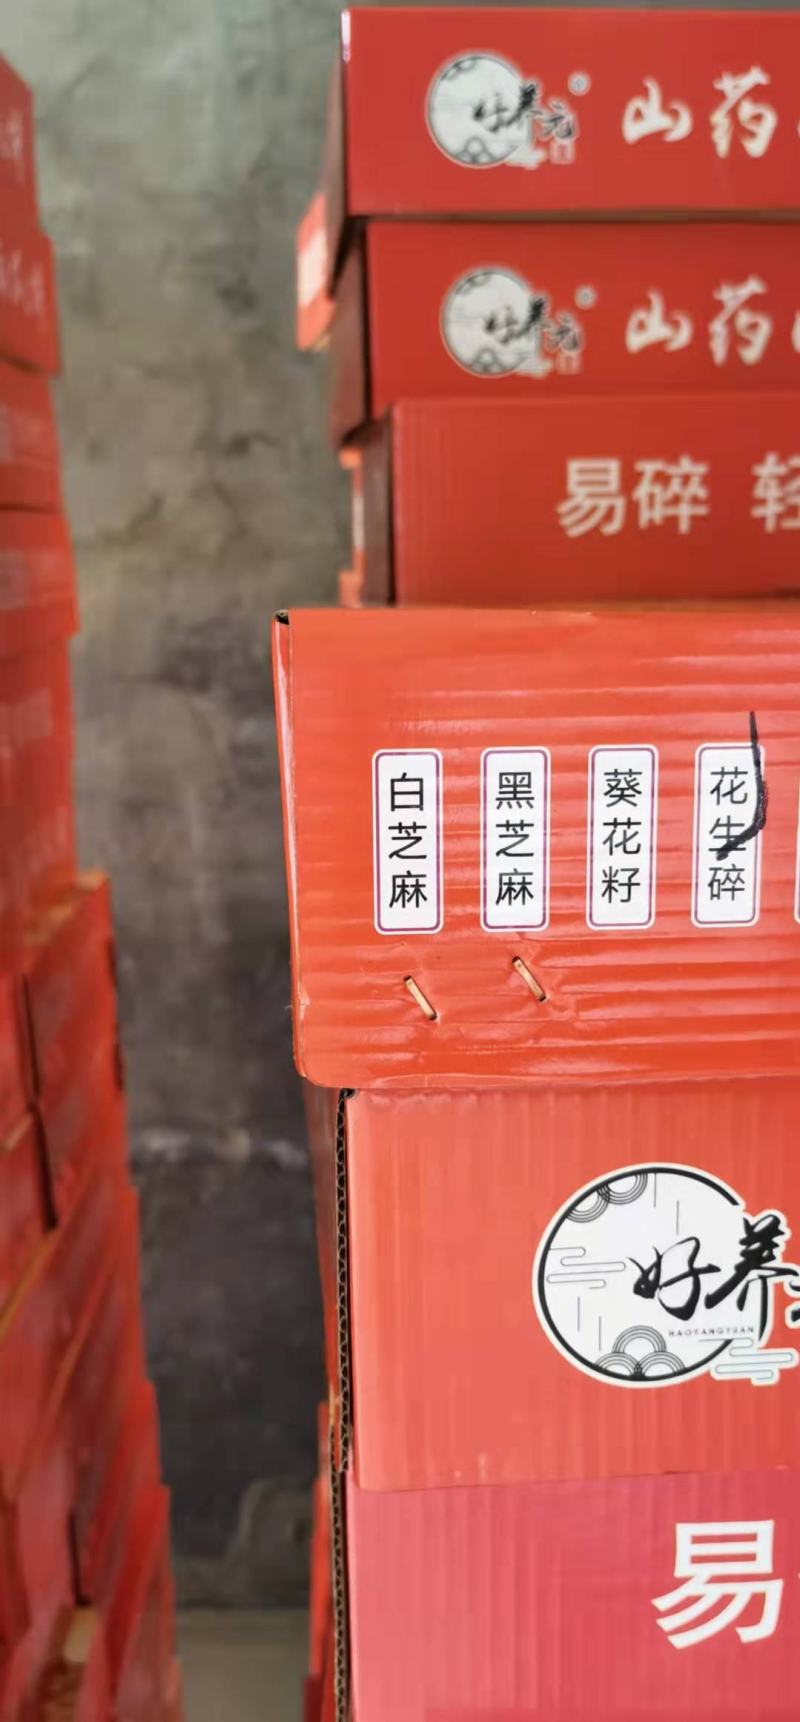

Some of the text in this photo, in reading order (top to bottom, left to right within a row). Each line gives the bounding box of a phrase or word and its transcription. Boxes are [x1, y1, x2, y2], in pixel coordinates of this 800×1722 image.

[622, 66, 800, 159] 山药
[624, 274, 800, 367] 山药
[557, 454, 709, 537] 易碎
[388, 772, 428, 909] 白芝麻
[495, 771, 535, 906] 黑芝麻
[601, 768, 642, 904] 葵花籽
[707, 766, 749, 901] 花生碎
[626, 1213, 800, 1342] 好养
[651, 1519, 784, 1649] 易
